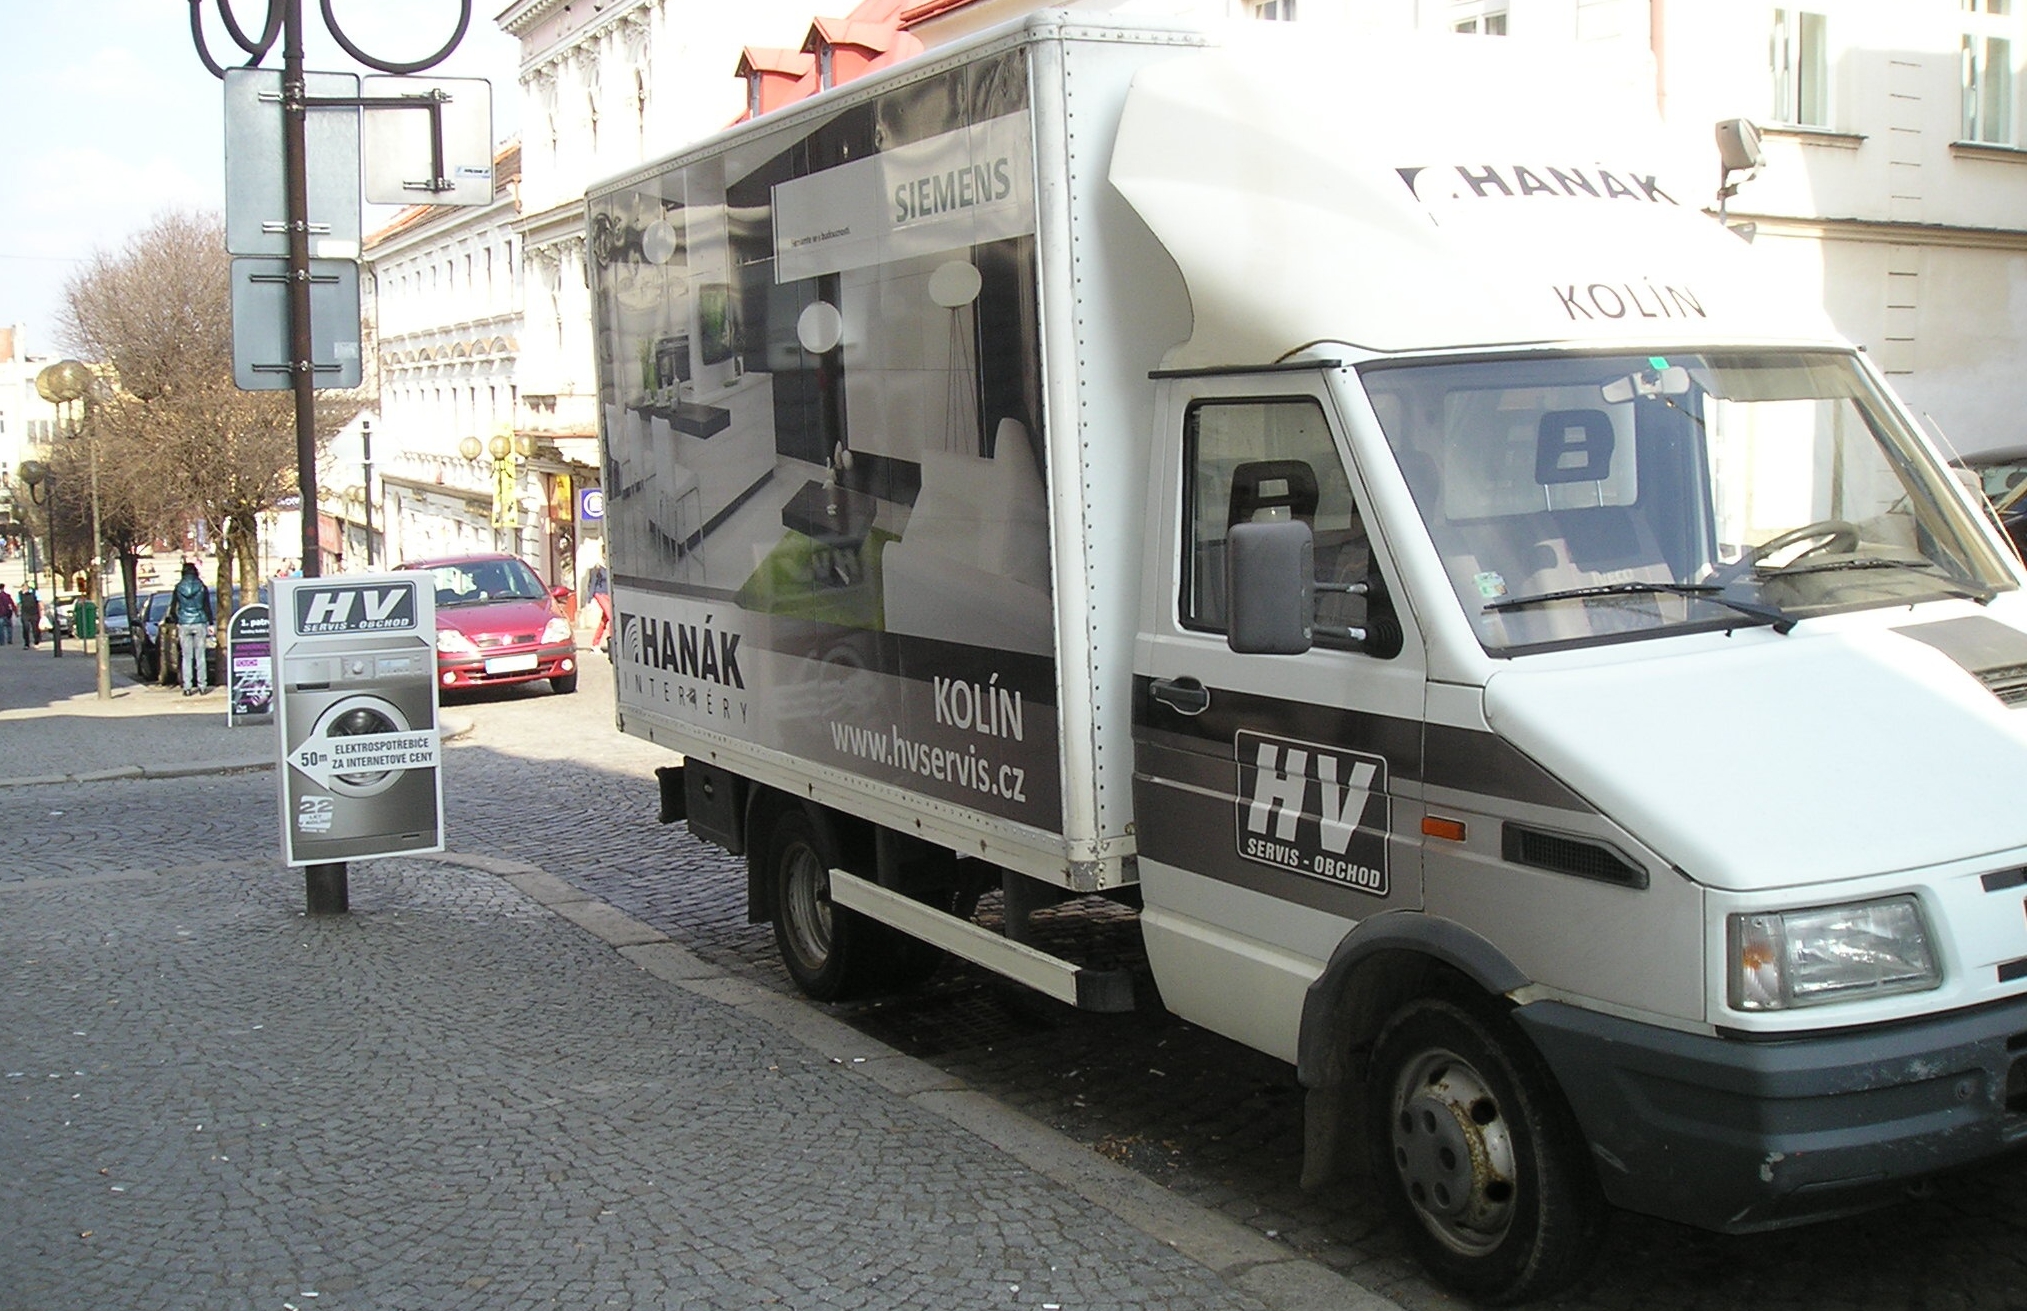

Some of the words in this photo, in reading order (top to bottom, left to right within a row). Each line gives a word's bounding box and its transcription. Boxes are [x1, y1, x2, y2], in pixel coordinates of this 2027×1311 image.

[895, 157, 1010, 222] SIEMENS
[303, 621, 348, 632] SERVIS
[359, 618, 410, 629] OBCHOD
[305, 588, 408, 624] HV
[640, 614, 746, 691] HANÁK
[933, 672, 1024, 742] KOLÍN
[332, 759, 345, 769] ZA
[409, 751, 434, 763] CENY
[830, 720, 1027, 803] www.hvservis.cz
[1247, 742, 1377, 855] HV
[1247, 837, 1300, 867] SERVIS
[1314, 854, 1381, 889] OBCHOD
